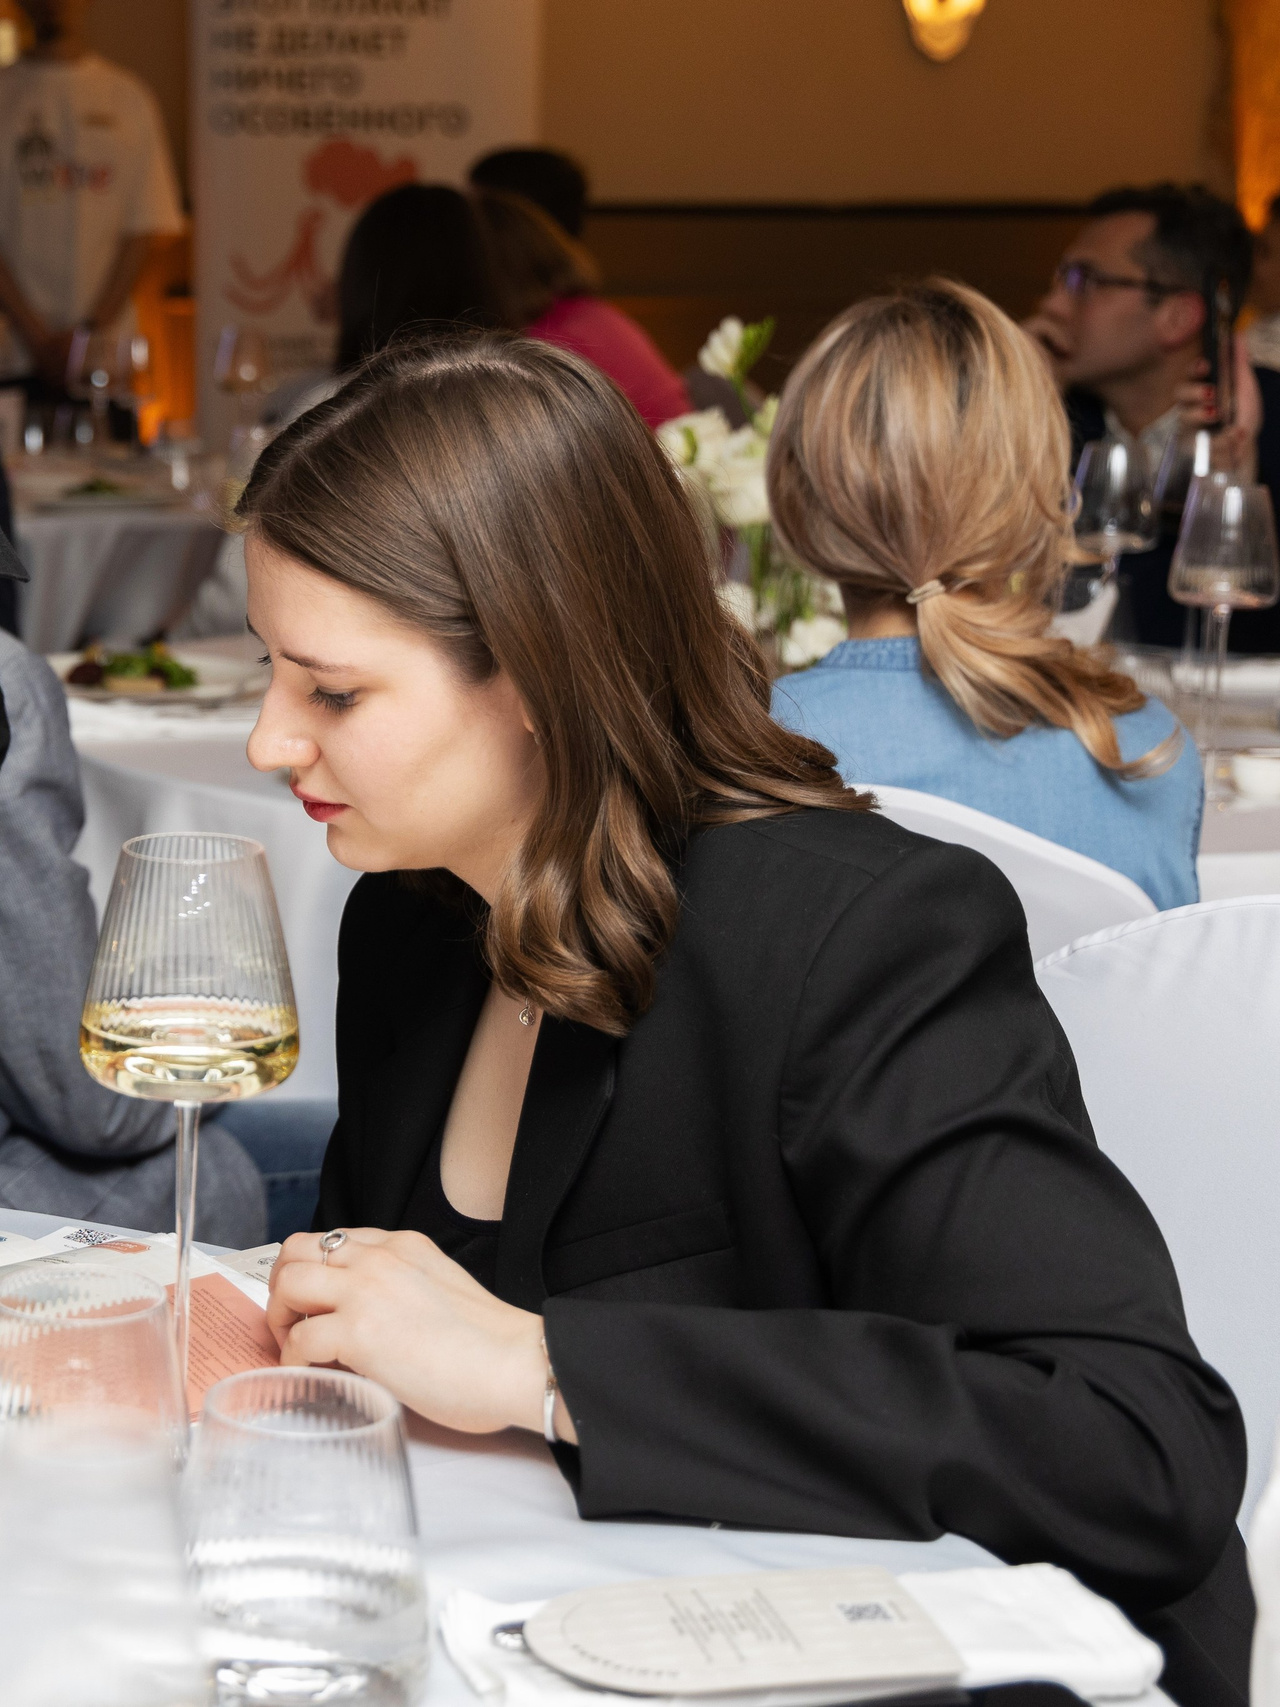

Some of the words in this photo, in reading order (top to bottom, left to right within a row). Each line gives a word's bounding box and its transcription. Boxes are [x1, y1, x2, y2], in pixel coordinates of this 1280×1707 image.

[268, 25, 409, 57] ДЕЛАЕТ
[210, 64, 361, 96] НИЧЕГО
[211, 102, 469, 135] ОСОБЕННОГО
